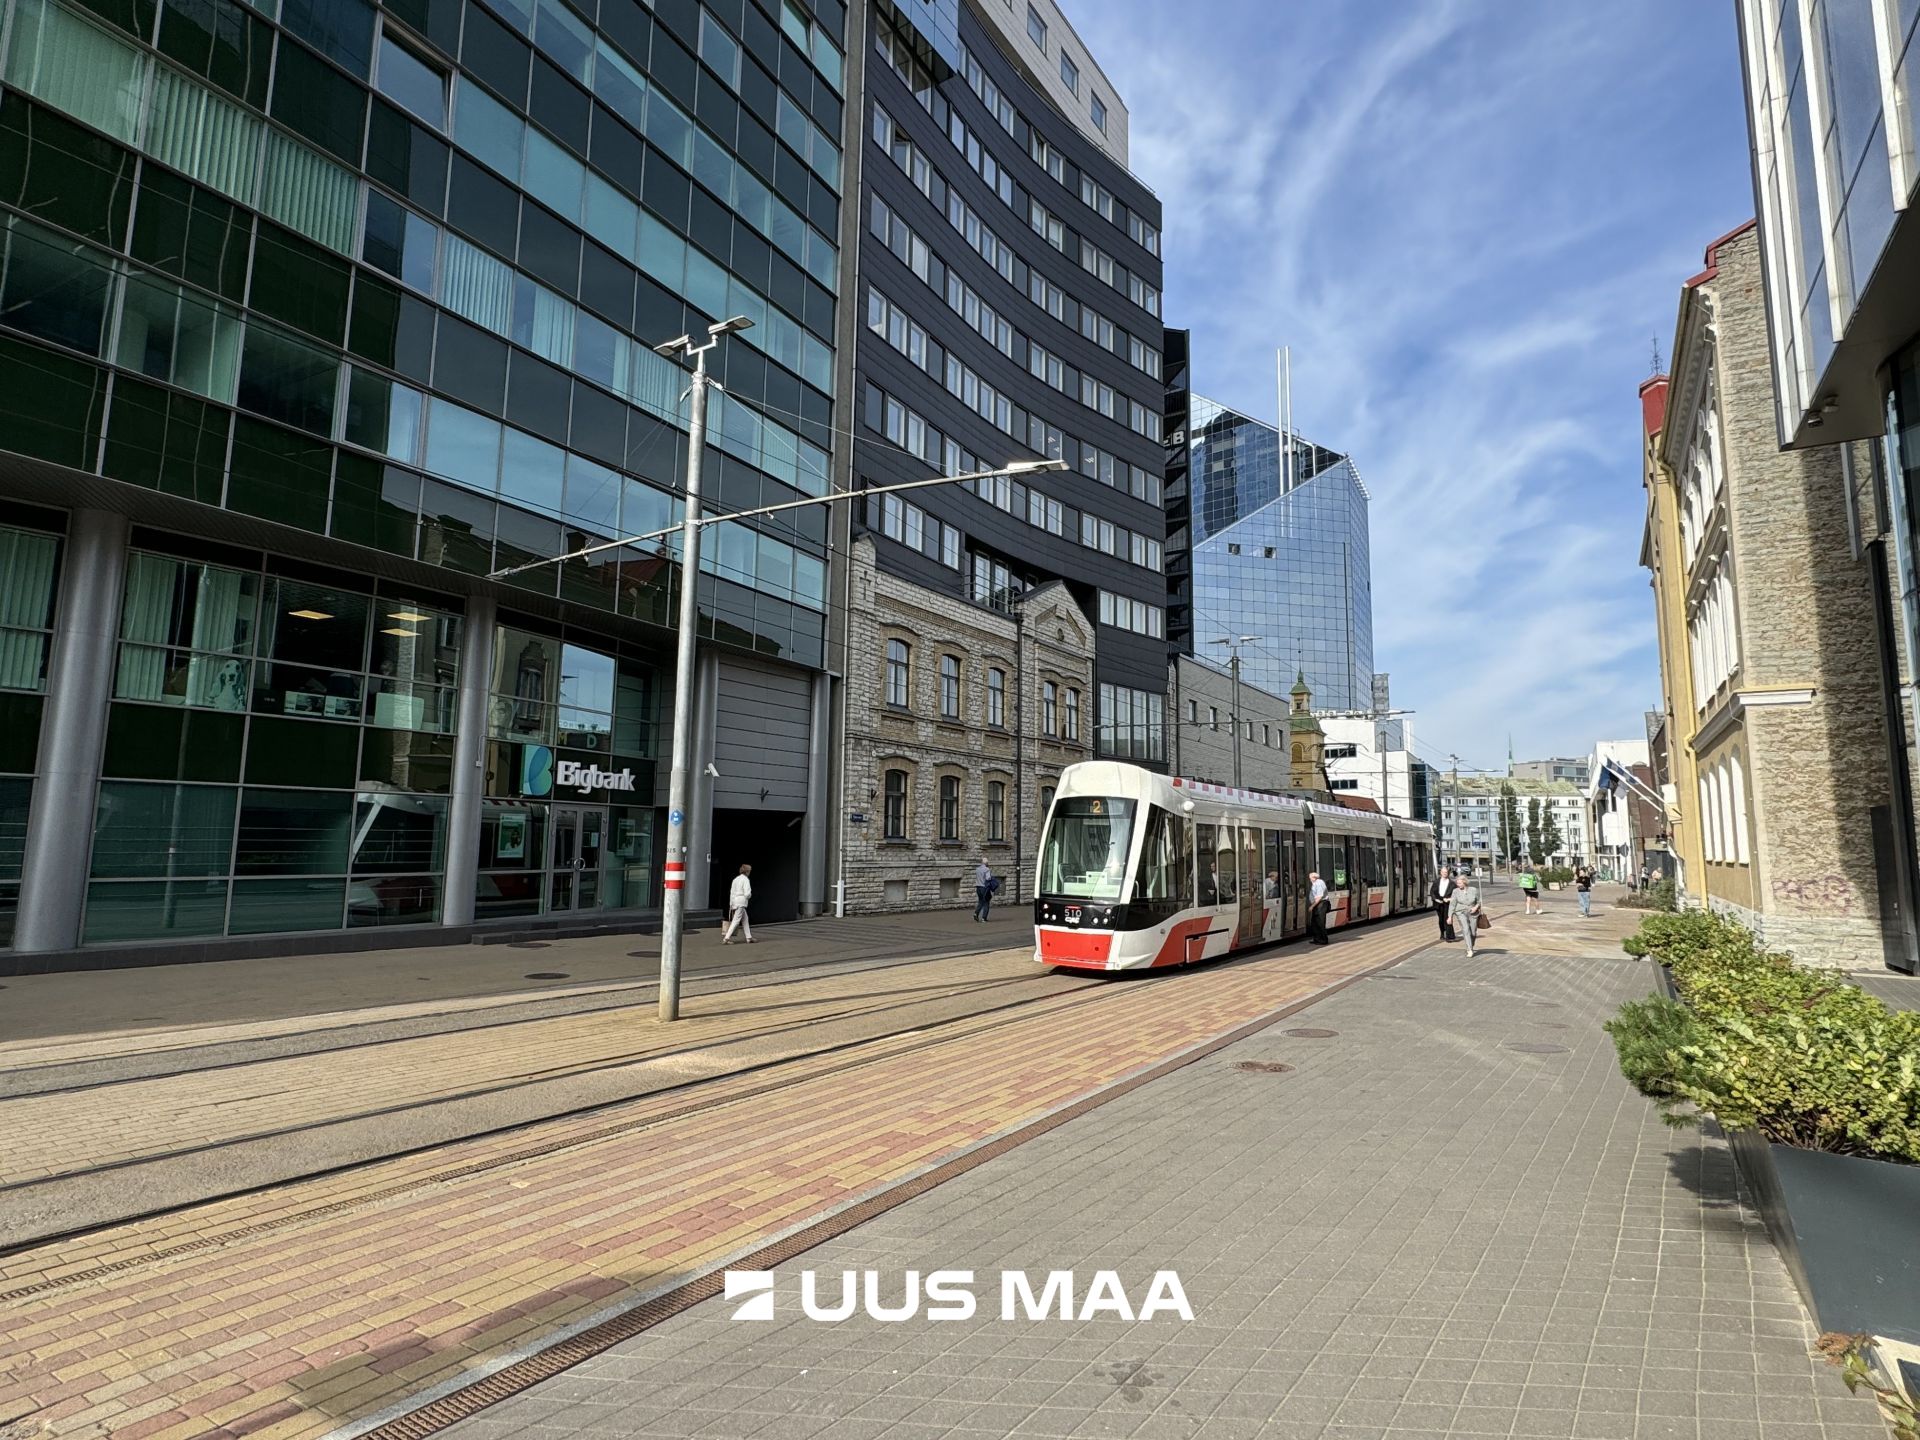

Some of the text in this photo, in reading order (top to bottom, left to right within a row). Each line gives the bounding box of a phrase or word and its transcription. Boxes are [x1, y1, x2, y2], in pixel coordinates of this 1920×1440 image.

[557, 760, 636, 794] Bigbank
[1092, 800, 1102, 813] 2
[1064, 908, 1082, 918] 510
